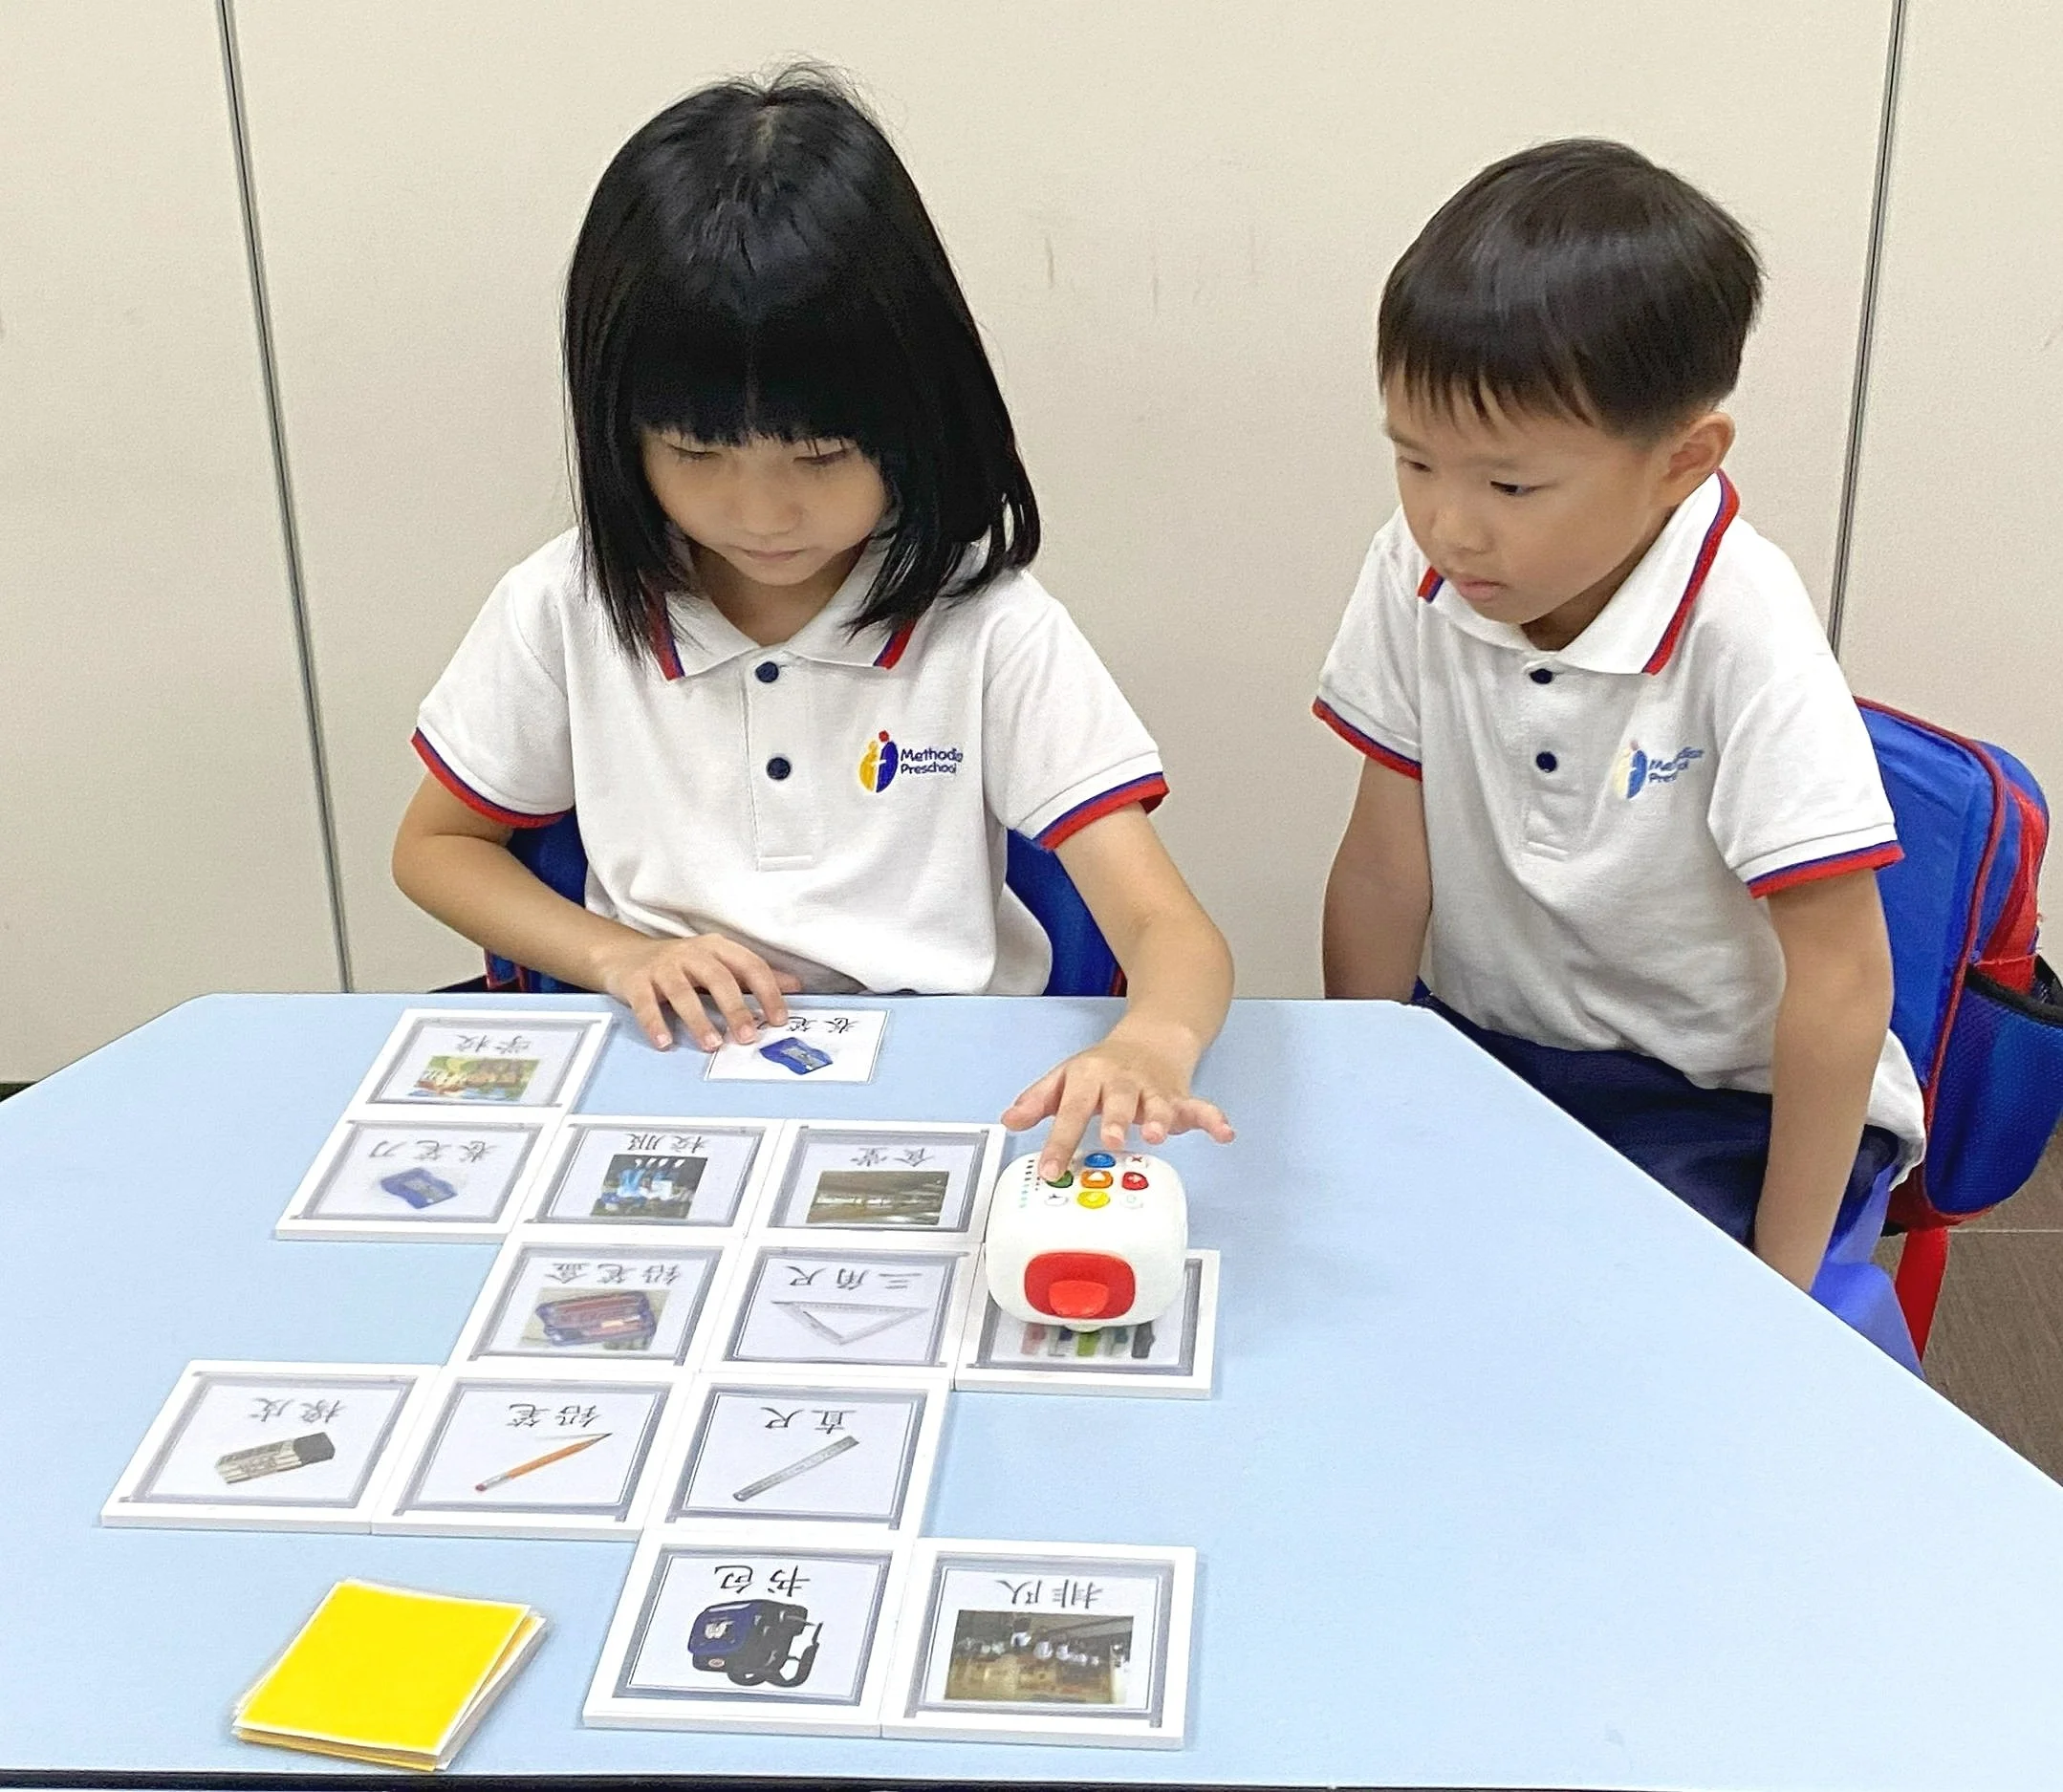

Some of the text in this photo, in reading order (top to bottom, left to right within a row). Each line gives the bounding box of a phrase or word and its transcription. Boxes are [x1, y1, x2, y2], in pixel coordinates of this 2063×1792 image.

[459, 1034, 532, 1052] 学校
[369, 1140, 498, 1162] 卷笔刀
[627, 1133, 706, 1155] 校服
[850, 1147, 934, 1167] 食堂
[544, 1263, 683, 1285] 铅笔盒
[786, 1265, 923, 1289] 三角尺
[250, 1396, 345, 1423] 橡皮
[508, 1404, 599, 1429] 铅笔
[761, 1406, 857, 1435] 直尺
[714, 1565, 811, 1597] 书包
[996, 1580, 1104, 1608] 排队
